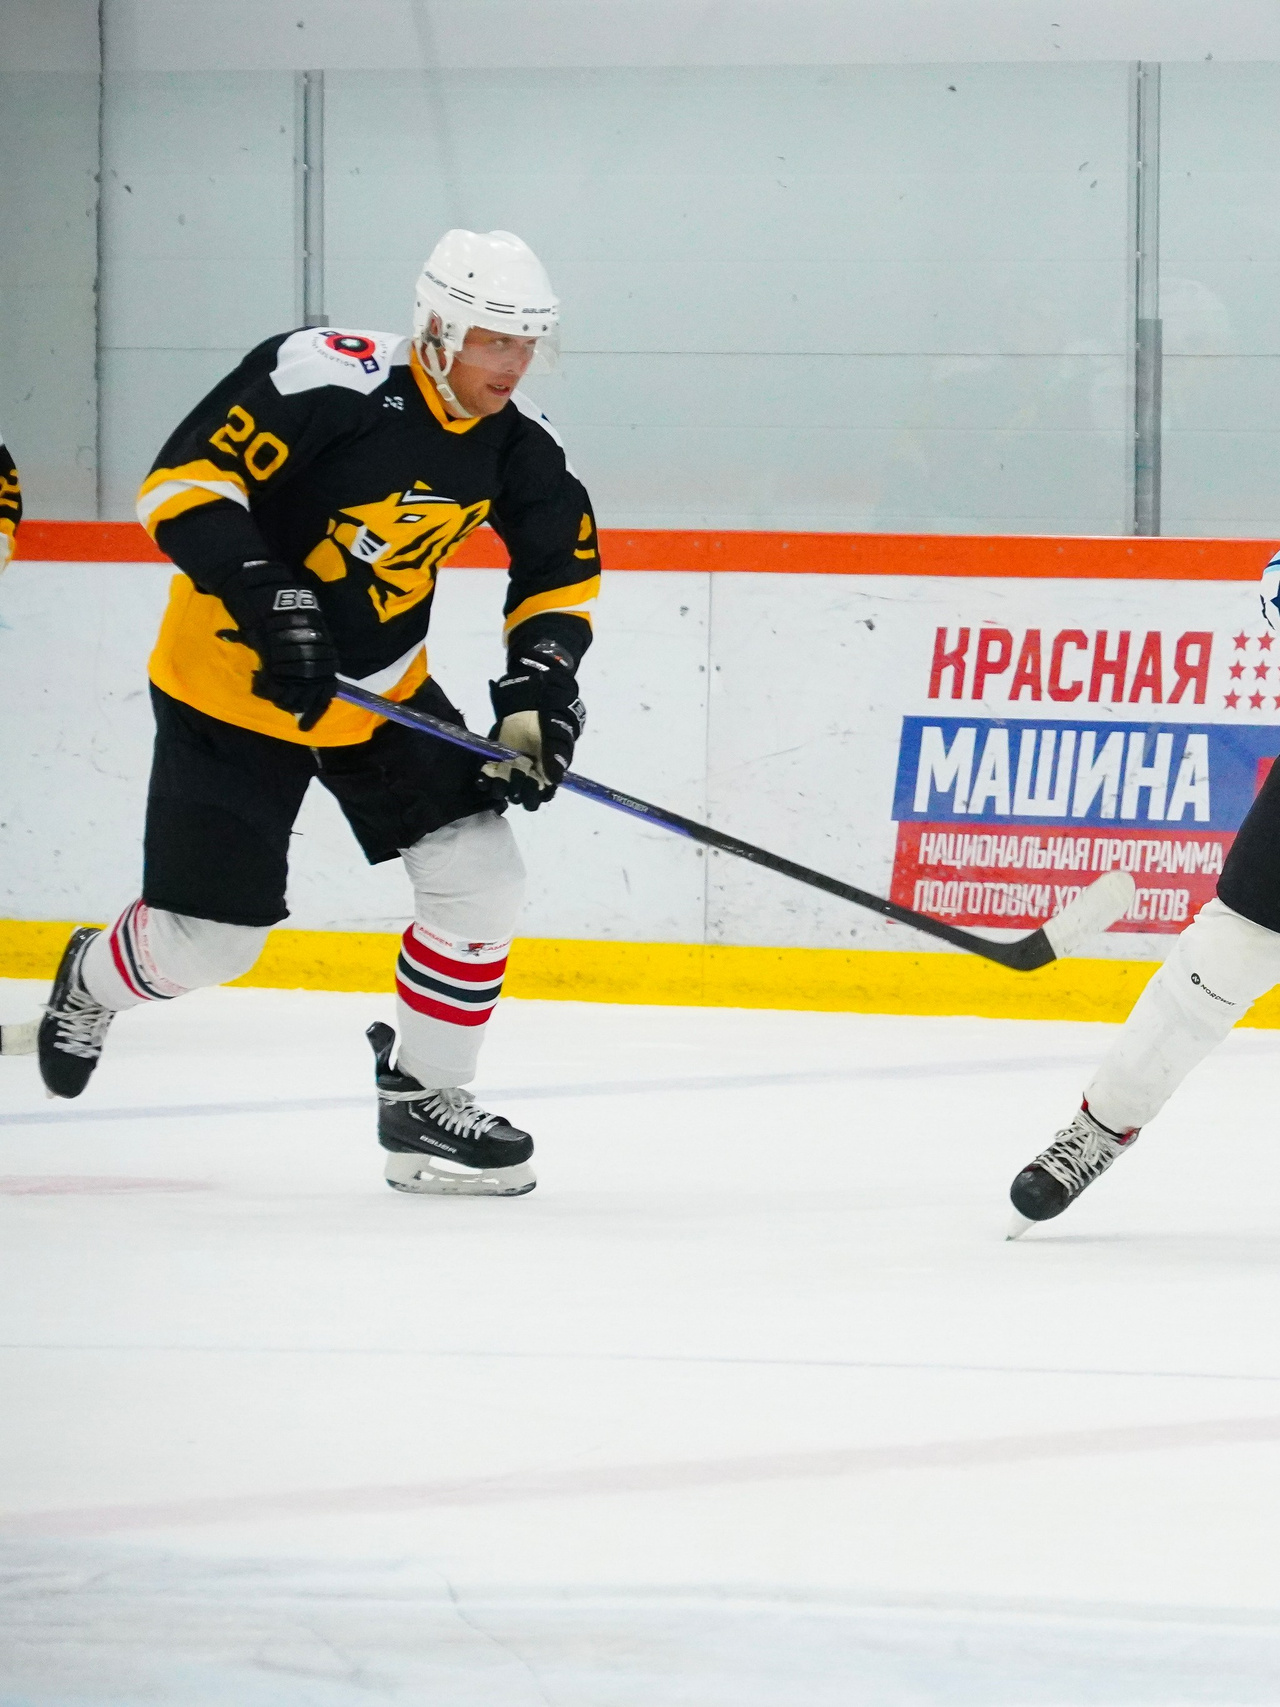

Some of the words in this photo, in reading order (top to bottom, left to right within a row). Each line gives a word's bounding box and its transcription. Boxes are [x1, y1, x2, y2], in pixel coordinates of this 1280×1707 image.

[208, 404, 290, 481] 20
[927, 626, 1214, 705] КРАСНАЯ
[912, 725, 1211, 822] МАШИНА
[918, 832, 1092, 870] НАЦИОНАЛЬНАЯ
[1091, 837, 1223, 875] ПРОГРАММА
[912, 880, 1050, 918] ПОДГОТОВКИ
[1052, 884, 1190, 922] ХОСТОВ
